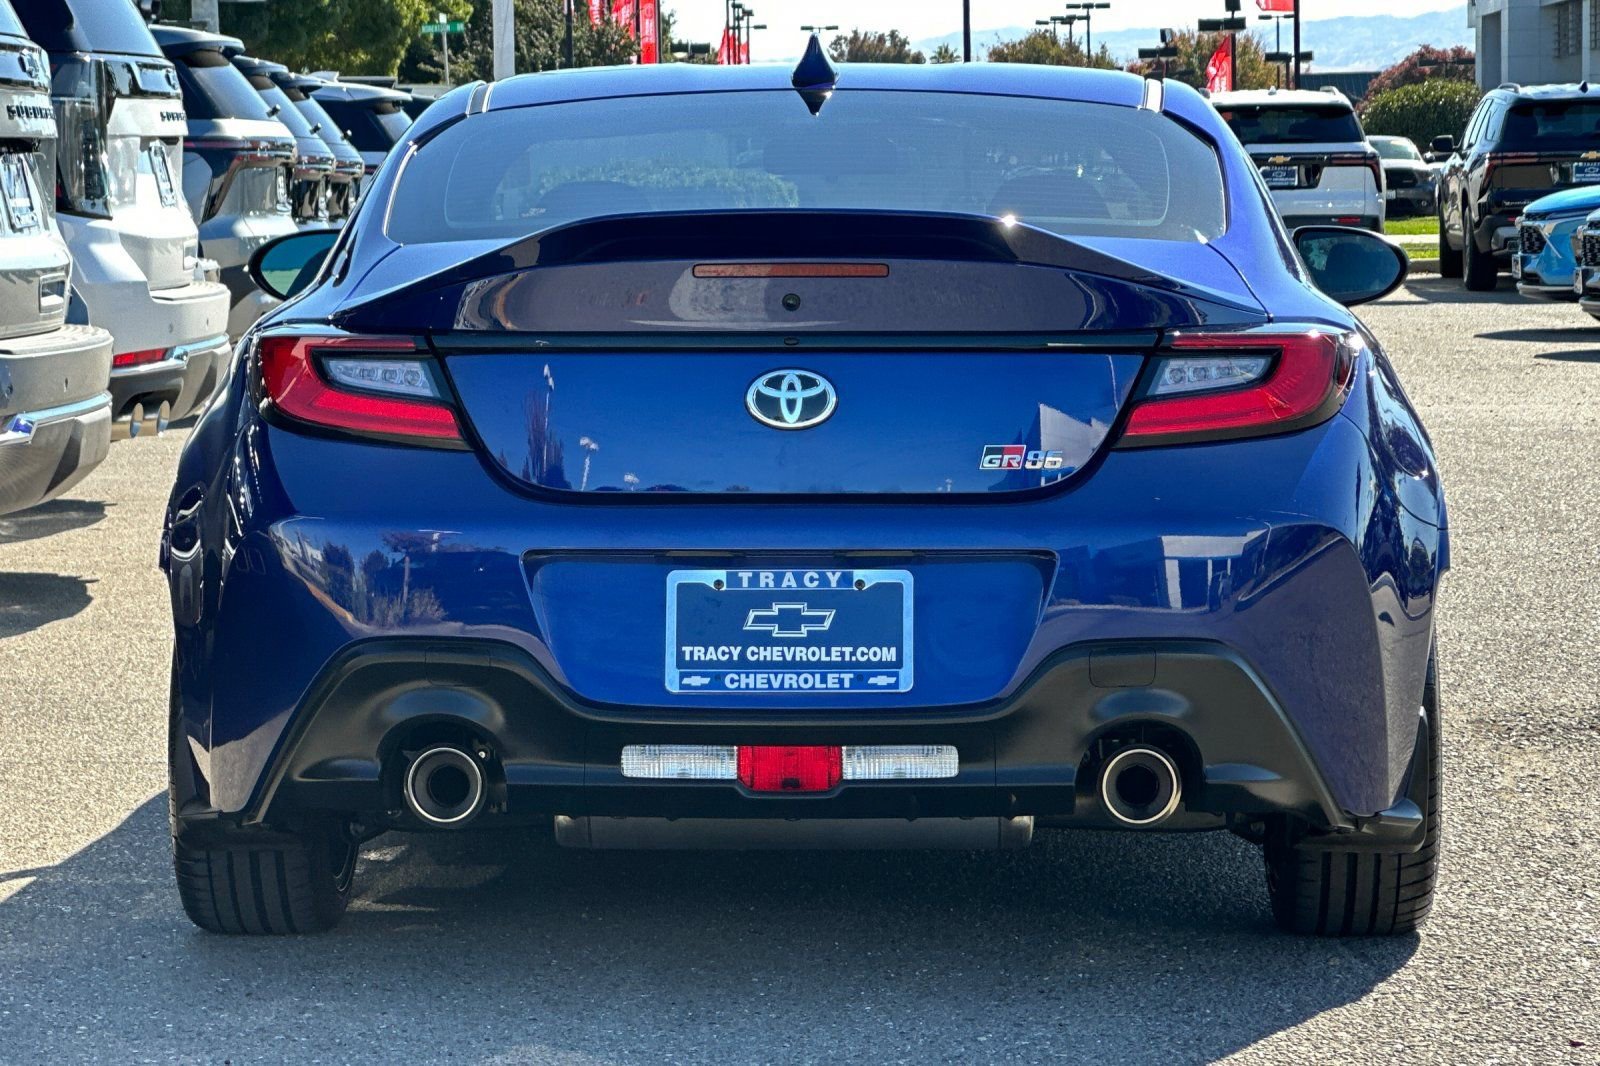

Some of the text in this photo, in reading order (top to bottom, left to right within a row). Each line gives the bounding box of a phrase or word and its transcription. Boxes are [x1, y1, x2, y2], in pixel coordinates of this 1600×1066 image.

[738, 572, 842, 588] TRACY
[681, 646, 896, 662] TRACY CHEVROLET.COM
[724, 673, 854, 689] CHEVROLET
